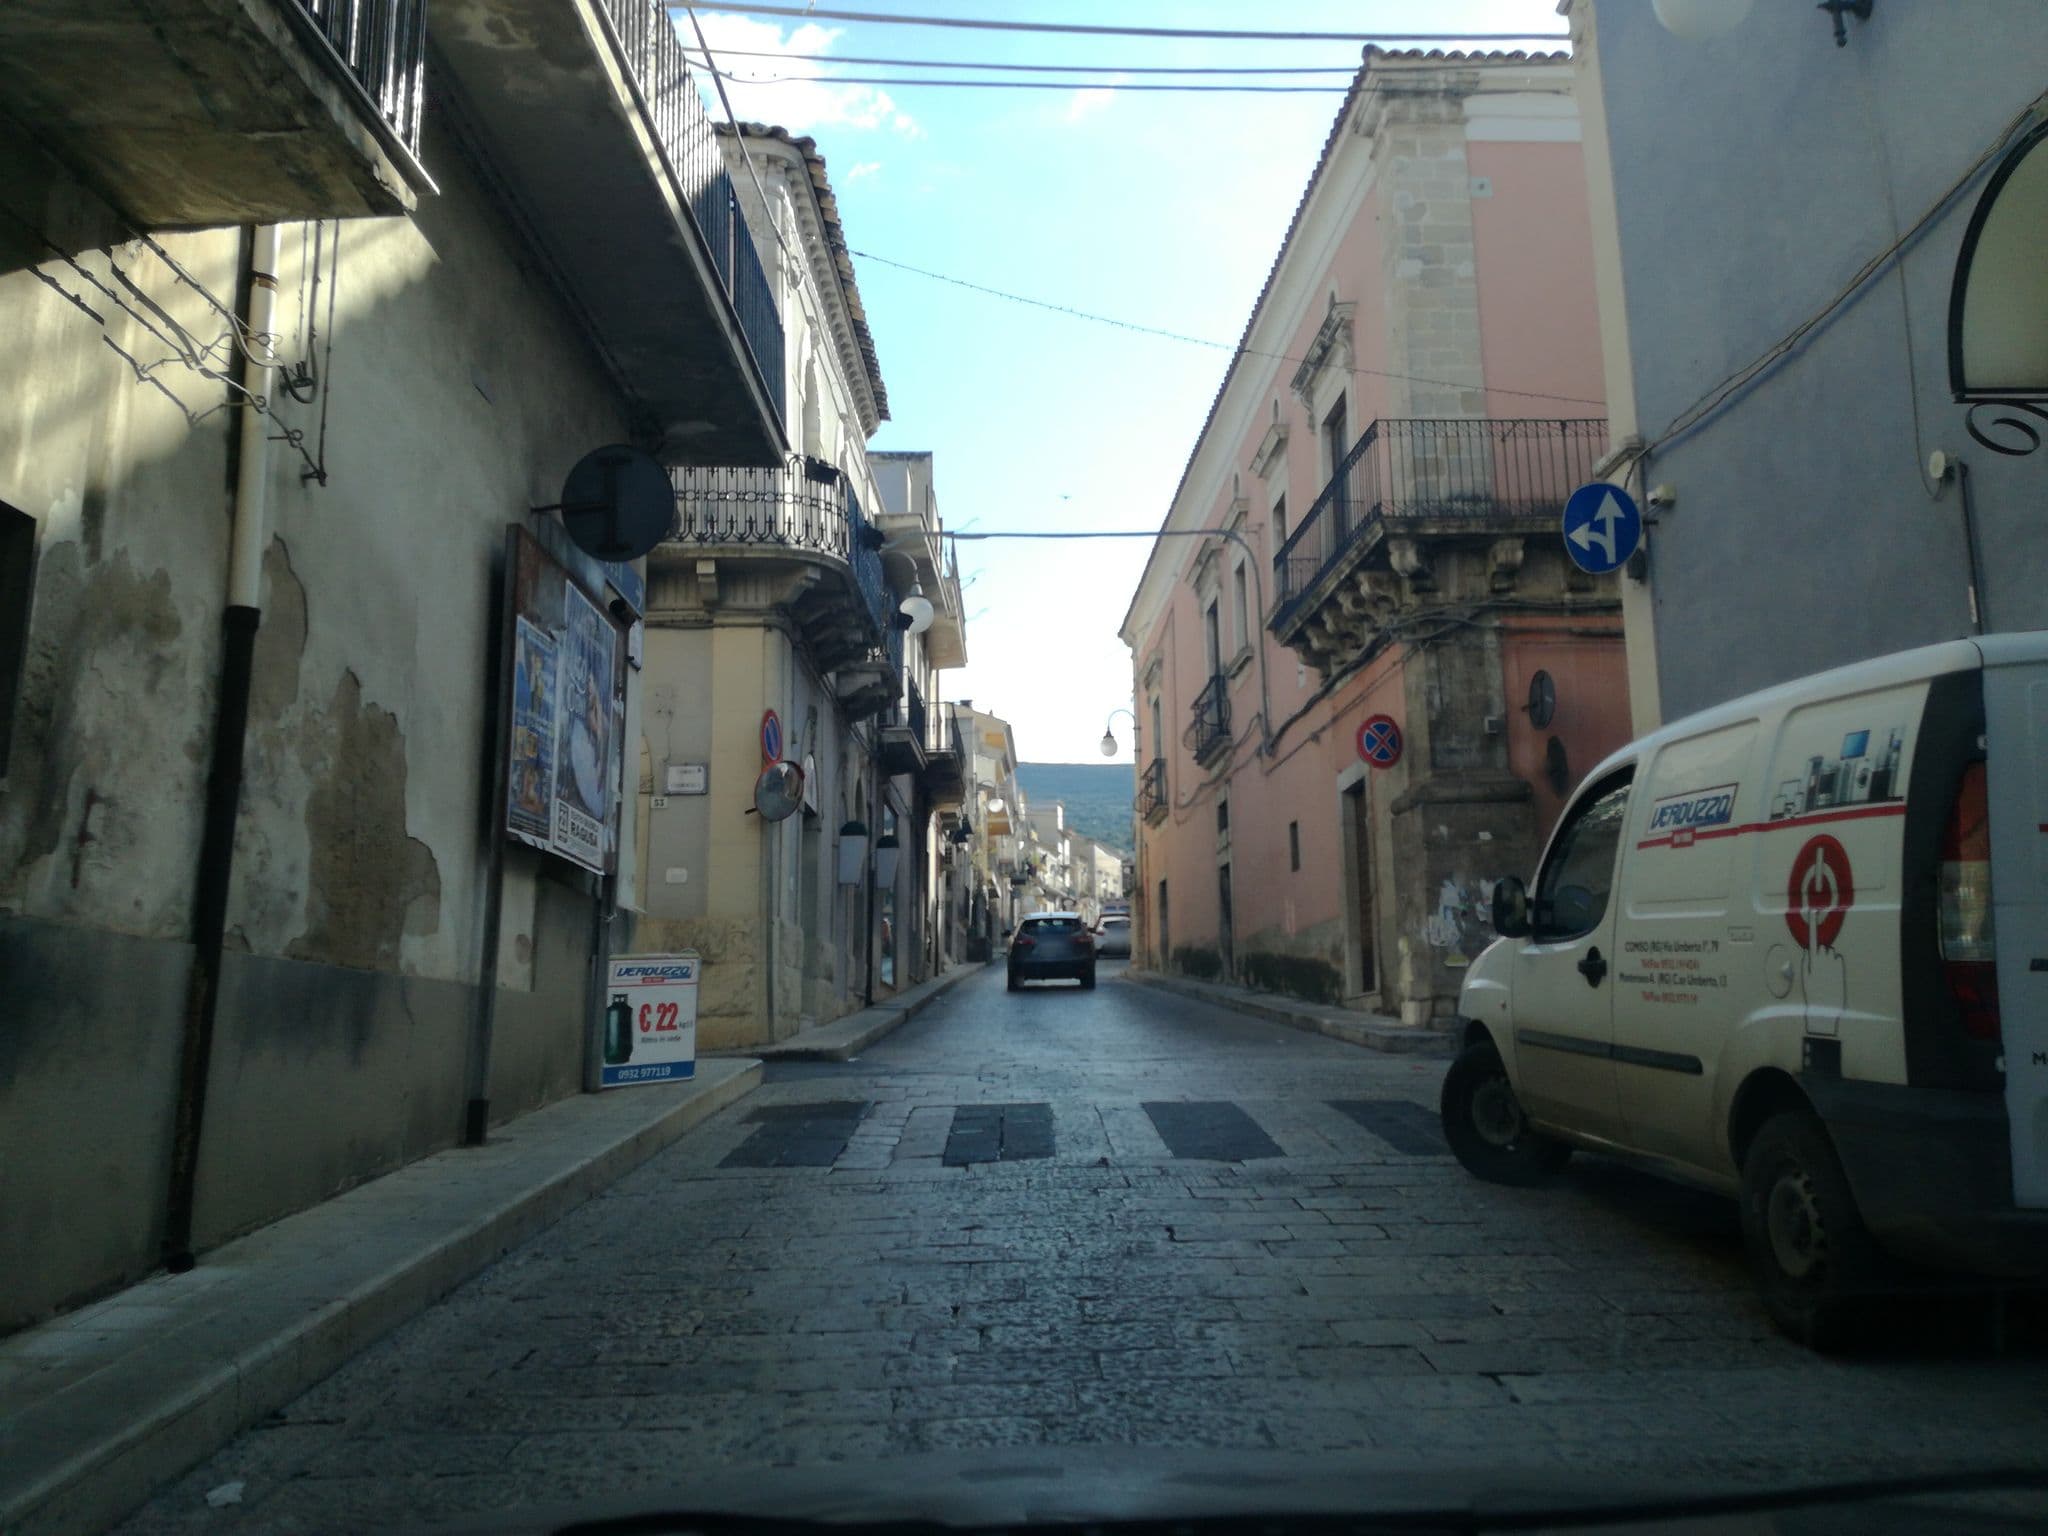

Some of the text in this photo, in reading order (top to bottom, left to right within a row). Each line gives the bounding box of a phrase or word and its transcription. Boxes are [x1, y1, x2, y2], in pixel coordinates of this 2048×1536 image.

[617, 966, 691, 979] VERDUZZO
[656, 1002, 679, 1031] 22
[2032, 1051, 2048, 1065] M
